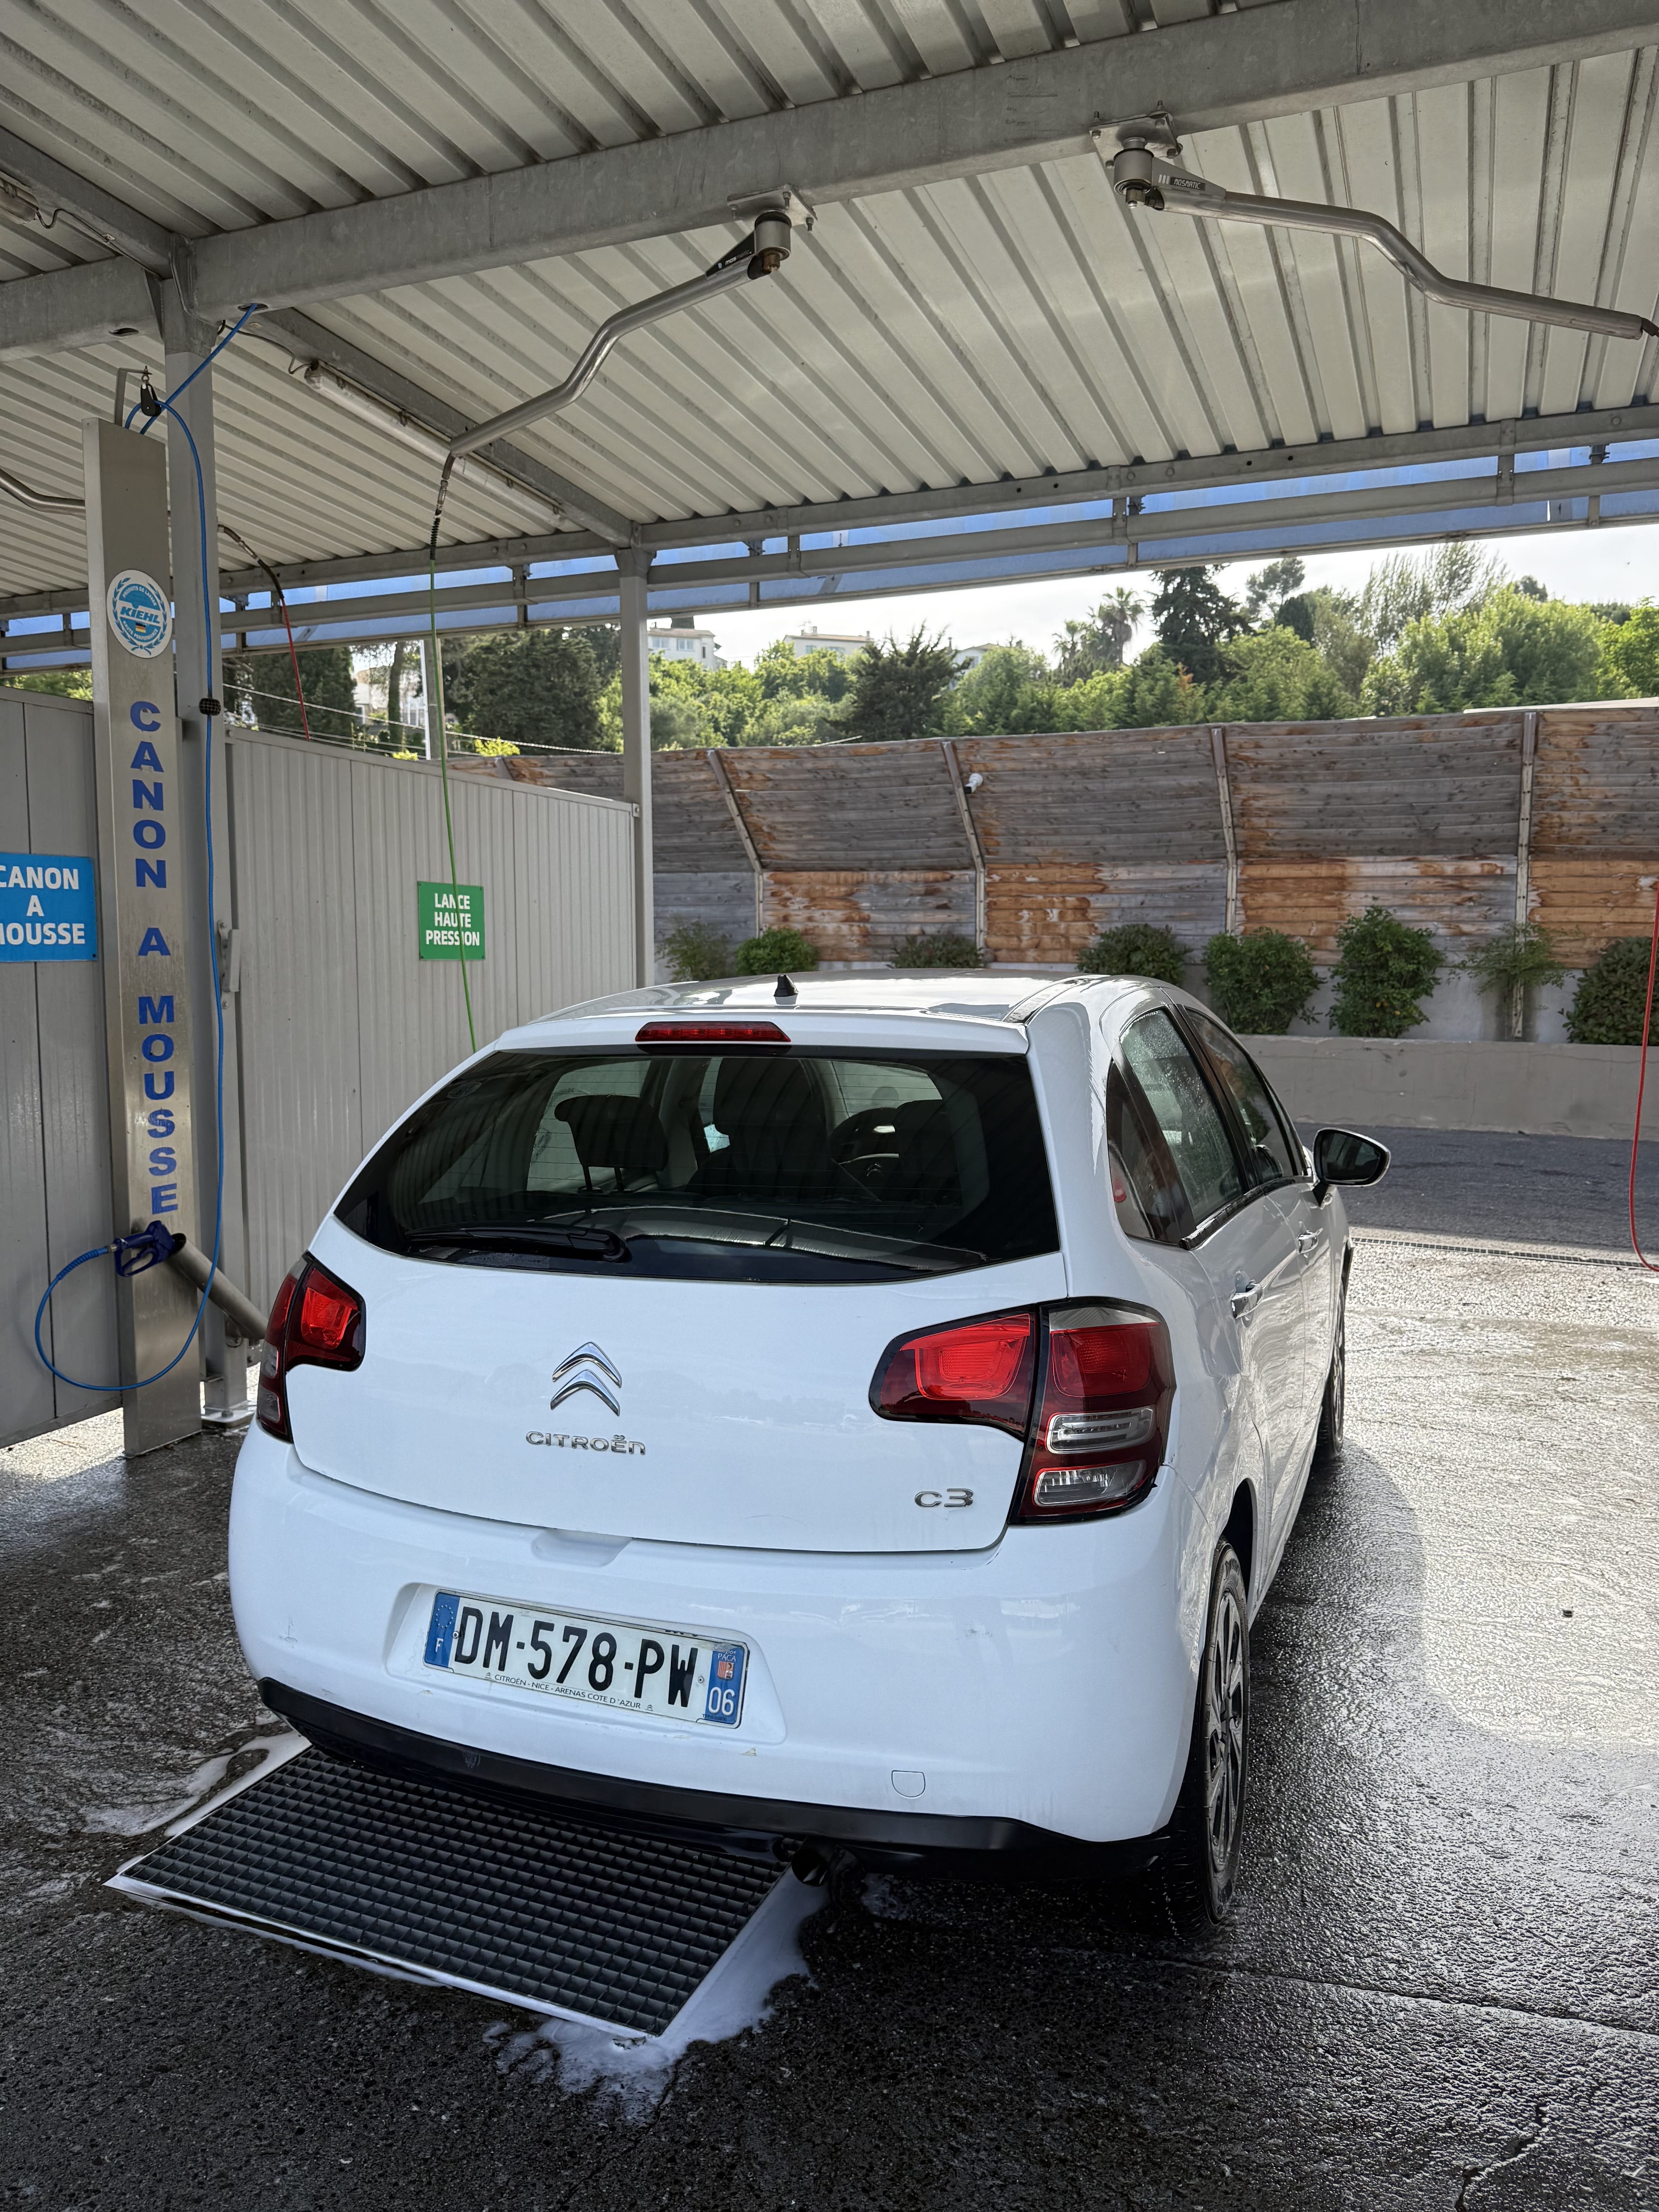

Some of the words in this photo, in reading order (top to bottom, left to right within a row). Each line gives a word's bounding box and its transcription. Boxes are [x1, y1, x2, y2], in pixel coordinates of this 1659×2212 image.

[120, 606, 160, 624] KIEHL
[130, 701, 167, 888] CANON
[26, 895, 45, 917] A
[434, 893, 470, 910] LANCE
[434, 911, 471, 928] HAUTE
[0, 923, 85, 945] OUSSE
[137, 927, 171, 956] A
[138, 995, 178, 1215] MOUSSE
[526, 1431, 646, 1455] CITROËN
[914, 1488, 974, 1507] C3
[435, 1638, 444, 1653] F
[455, 1606, 698, 1707] DM-578-PW
[718, 1653, 736, 1662] PACA
[495, 1674, 526, 1686] CITROËN
[532, 1682, 549, 1690] NICE
[555, 1687, 586, 1698] ARENAS
[587, 1693, 608, 1702] COTE
[708, 1686, 735, 1716] 06
